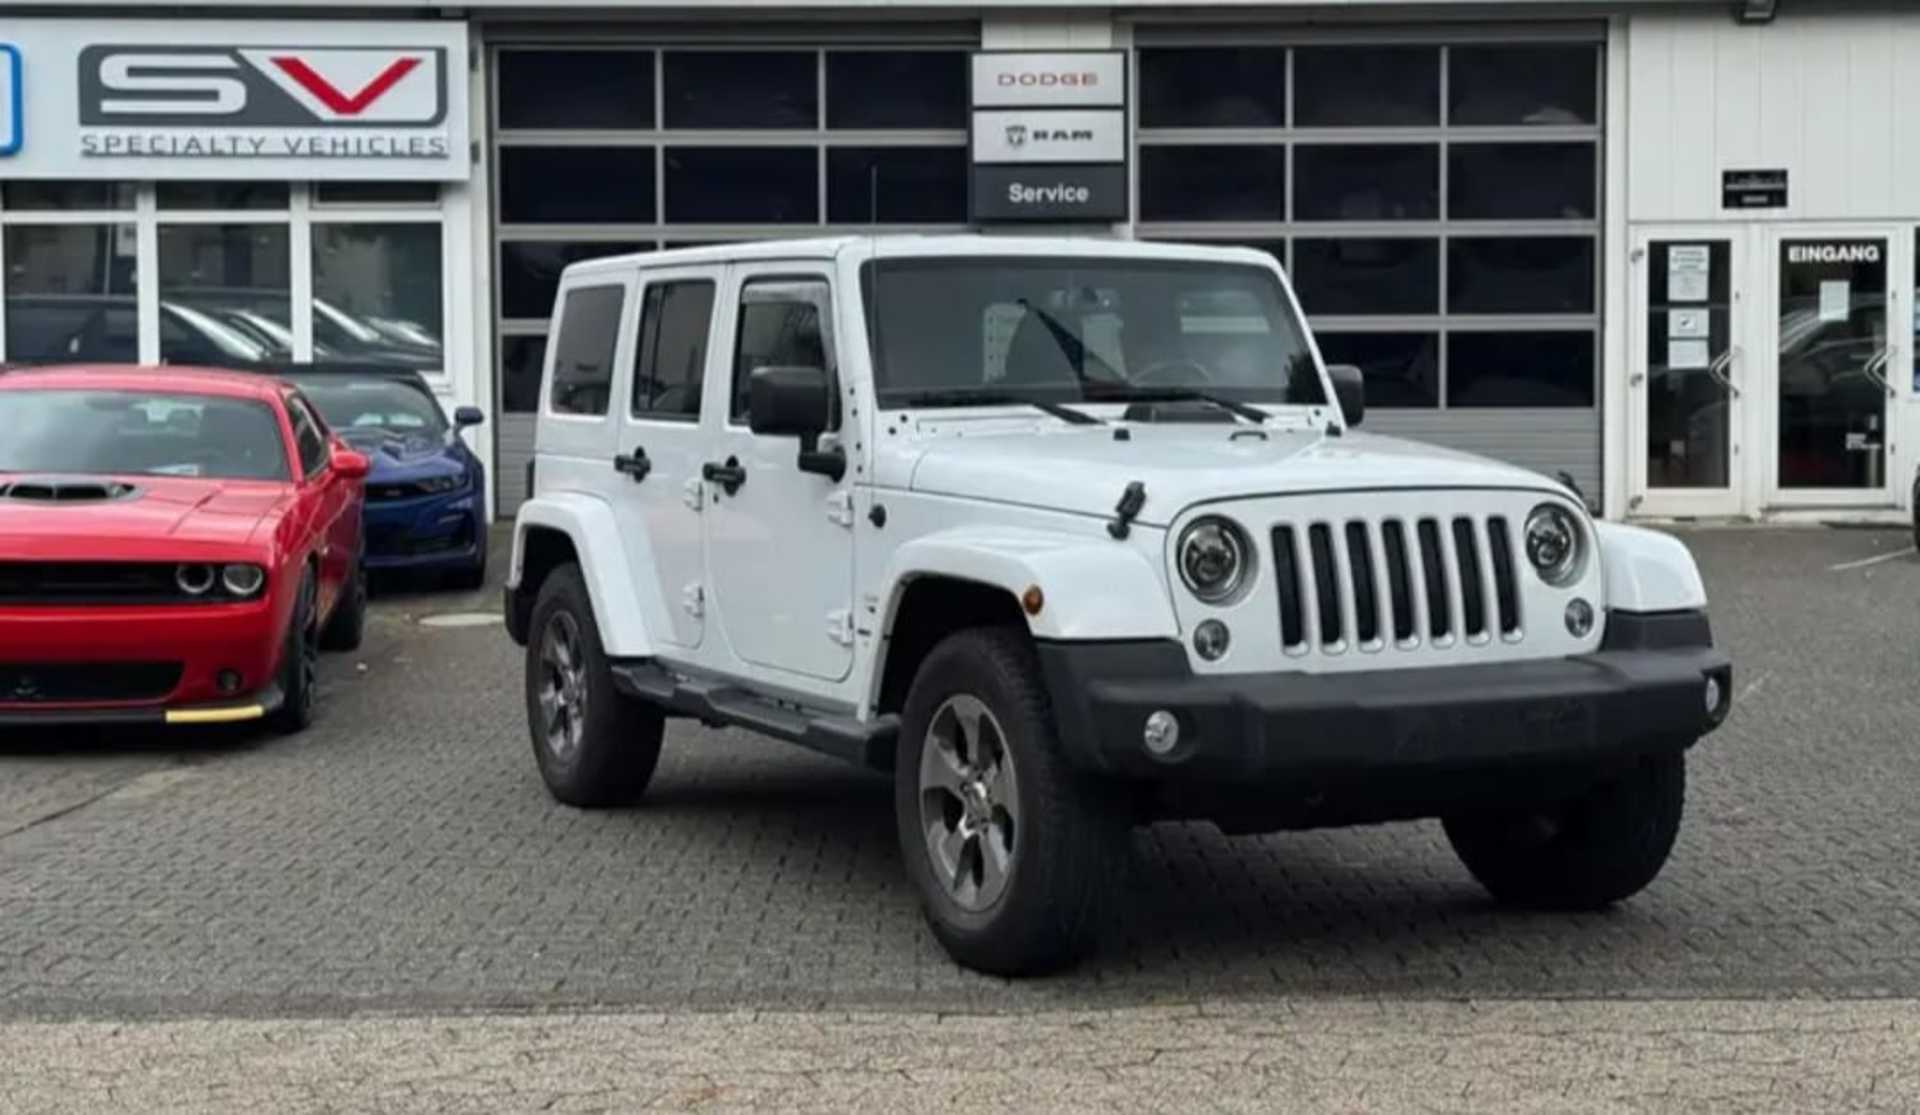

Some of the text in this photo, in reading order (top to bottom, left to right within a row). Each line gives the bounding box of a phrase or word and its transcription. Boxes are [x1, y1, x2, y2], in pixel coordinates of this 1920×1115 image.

[98, 53, 425, 116] SV
[997, 72, 1099, 87] DODGE
[80, 134, 446, 155] SPECIALTY VEHICLES
[1032, 129, 1094, 141] RAM
[1008, 183, 1089, 203] Service
[1788, 244, 1880, 263] EINGANG
